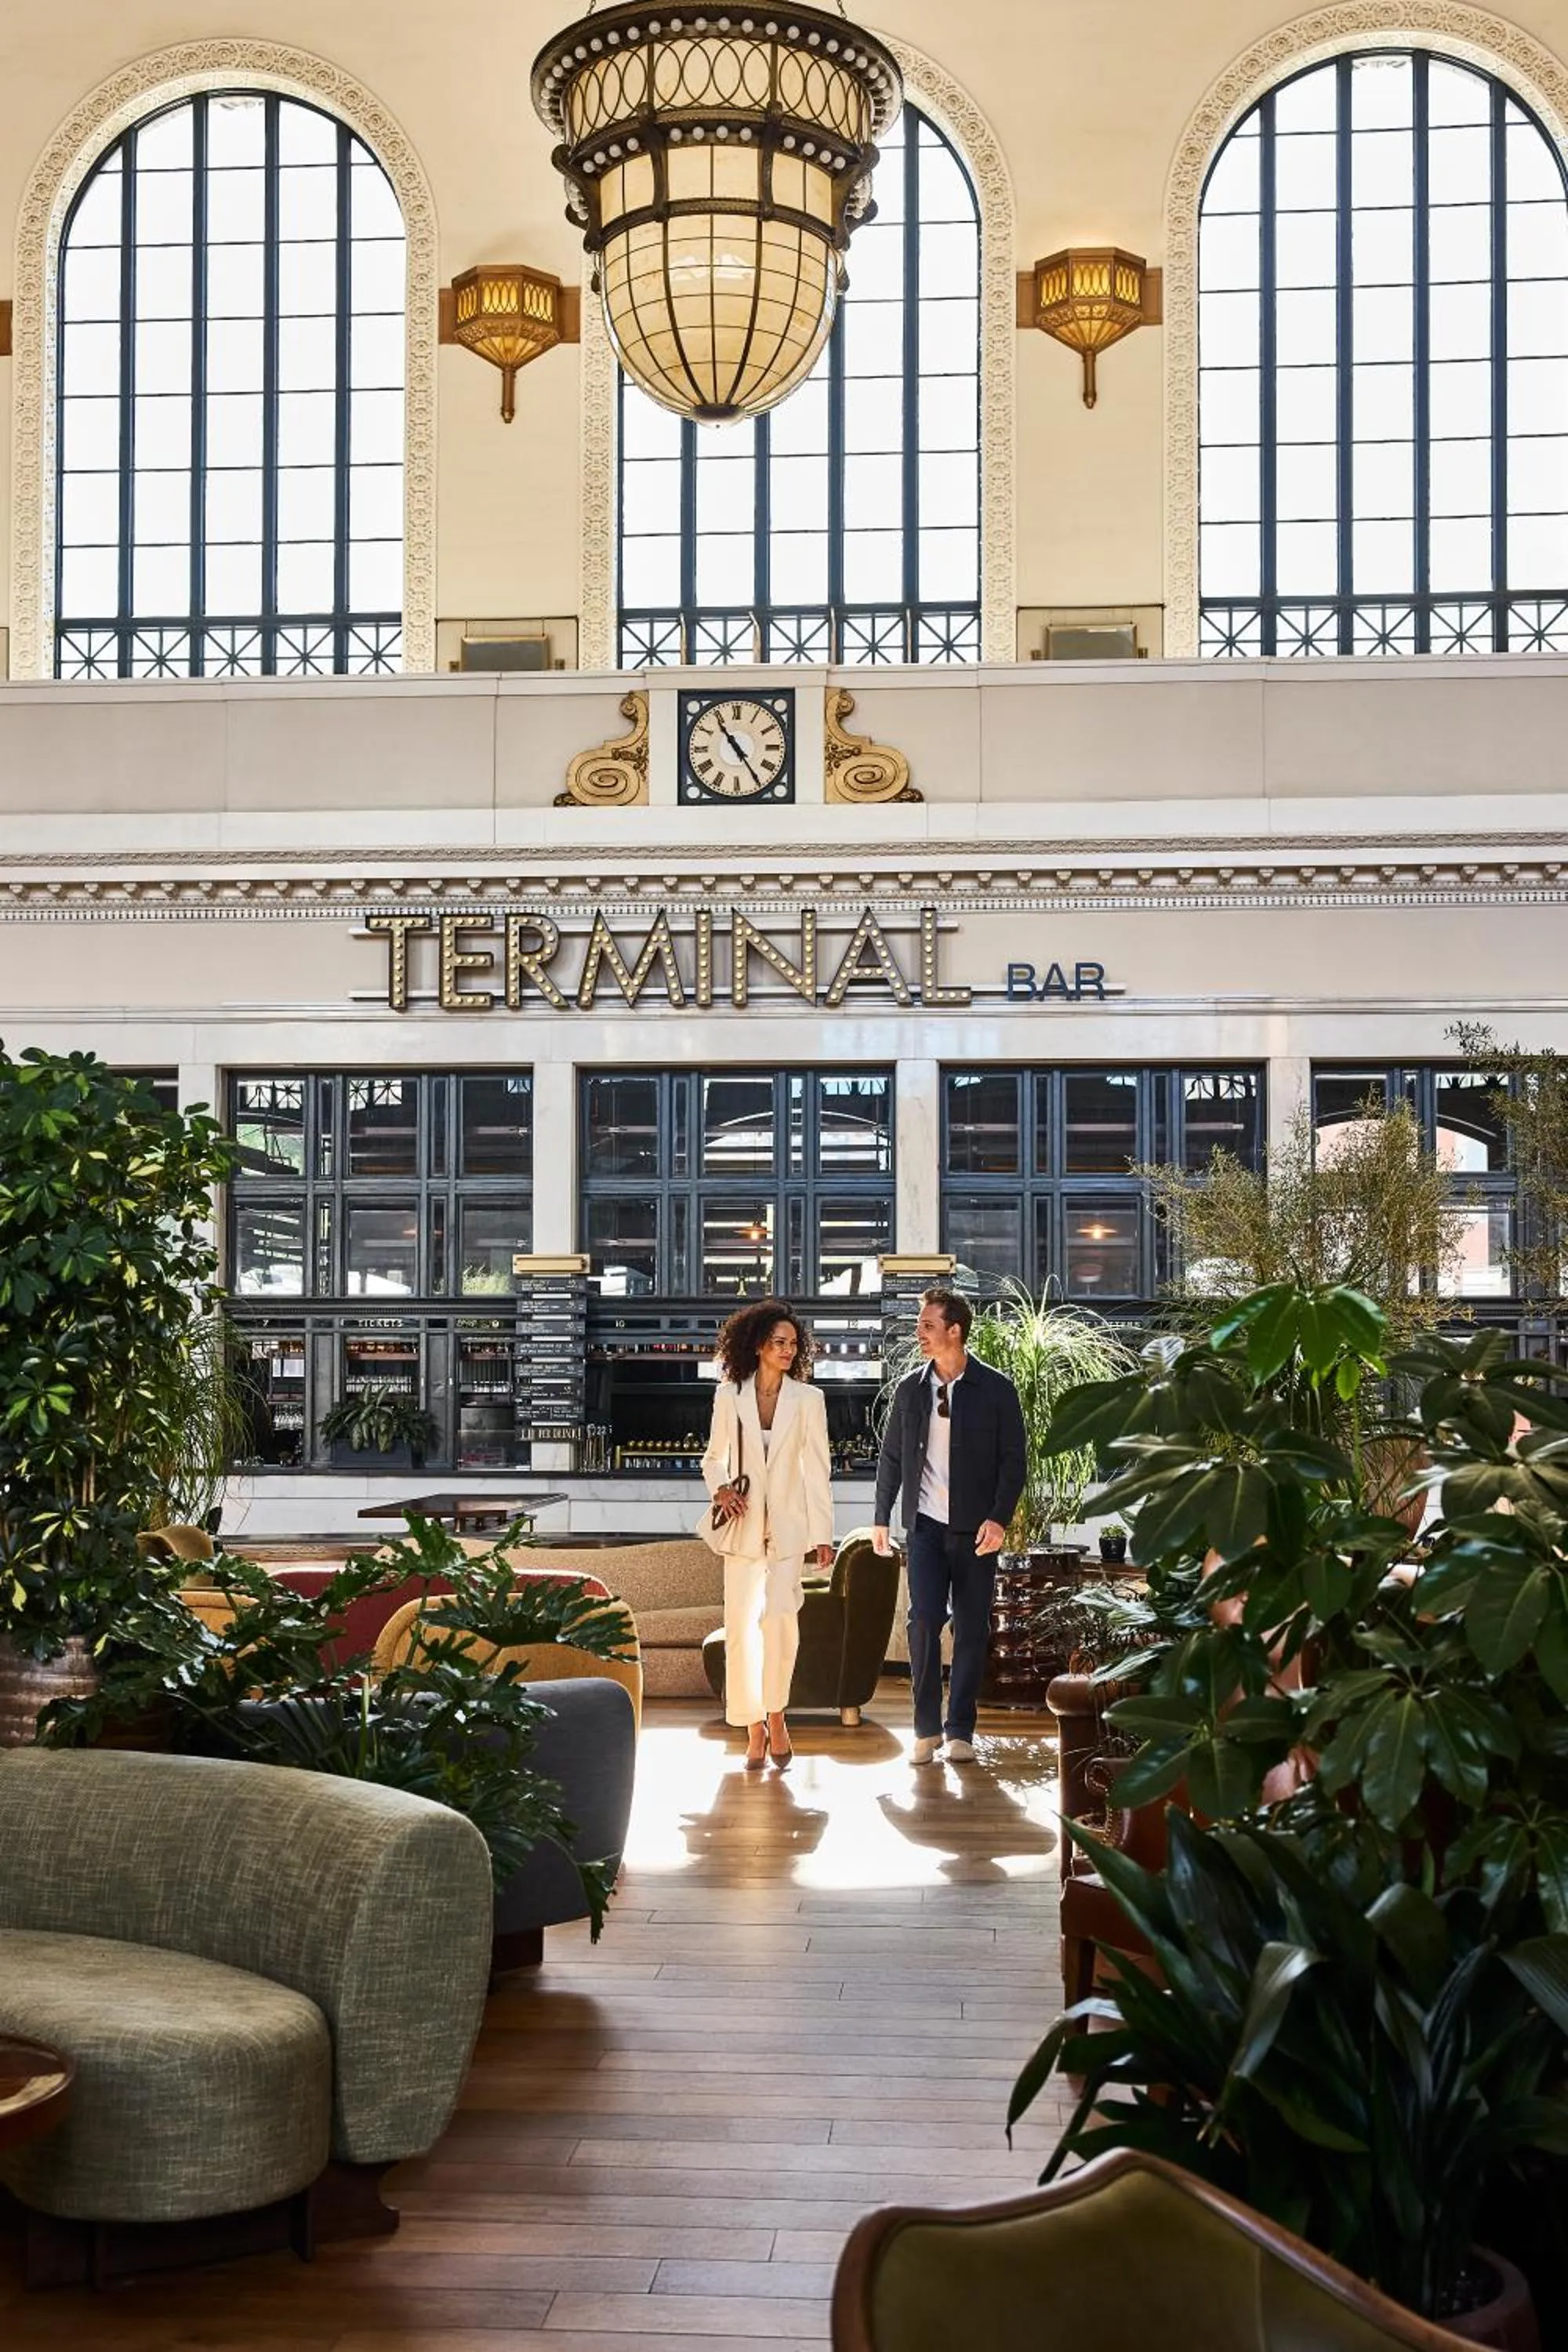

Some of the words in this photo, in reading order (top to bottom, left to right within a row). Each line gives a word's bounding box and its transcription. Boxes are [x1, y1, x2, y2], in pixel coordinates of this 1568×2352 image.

[365, 907, 971, 1010] TERMINAL
[1007, 961, 1106, 1000] BAR
[358, 1319, 403, 1327] TICKETS
